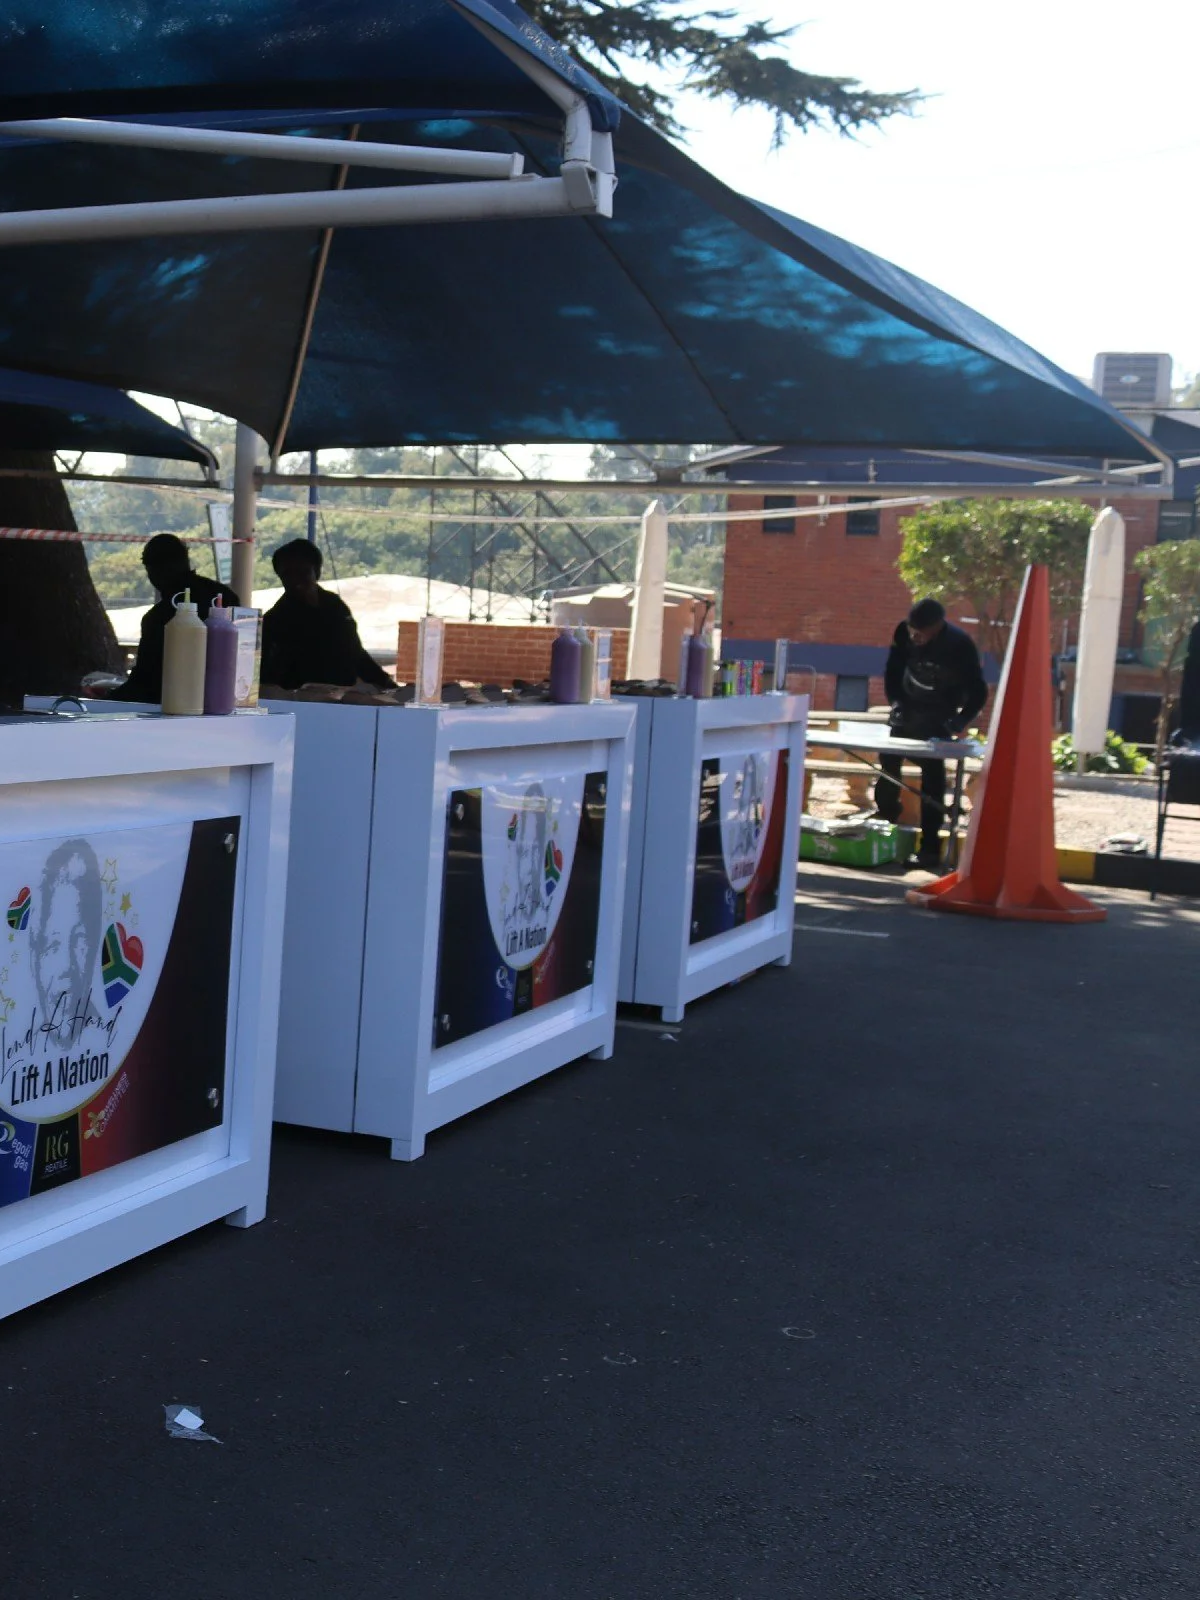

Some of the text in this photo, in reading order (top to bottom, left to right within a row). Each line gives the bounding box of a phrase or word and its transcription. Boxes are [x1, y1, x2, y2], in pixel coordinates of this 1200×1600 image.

[0, 1006, 38, 1085] Lend
[66, 987, 123, 1049] Hand
[10, 1049, 109, 1106] Lift A Nation
[11, 1138, 32, 1159] egoli
[13, 1156, 29, 1172] gas
